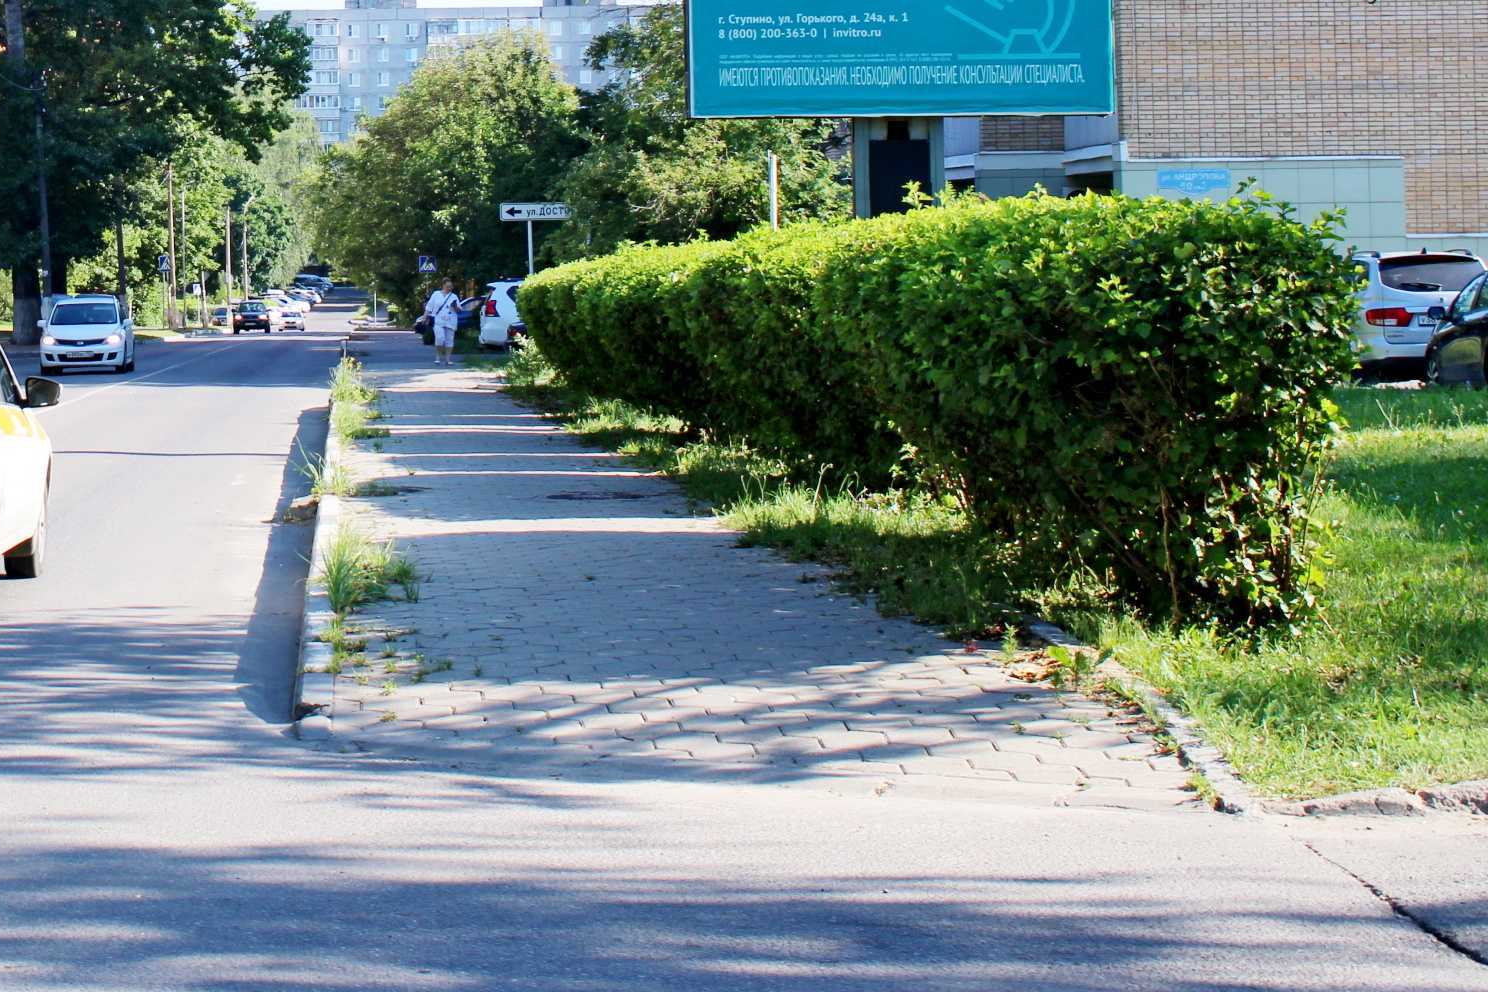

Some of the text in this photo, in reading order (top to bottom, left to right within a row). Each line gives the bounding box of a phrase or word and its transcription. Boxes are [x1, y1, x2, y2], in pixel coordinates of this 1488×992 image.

[718, 12, 909, 26] г. Ступино, ул. Горького, д. 24а, к. 1
[718, 27, 882, 40] 8 (800) 200-363-0 invitro.ru
[719, 63, 1086, 88] ИМЕЮТСЯ ПРОТИВОПОКАЗАНИЯ. НЕОБХОДИМО ПОЛУЧЕНИЕ КОНСУЛЬТАЦИИ СПЕЦИАЛИСТА.
[539, 206, 571, 217] ДОСТО
